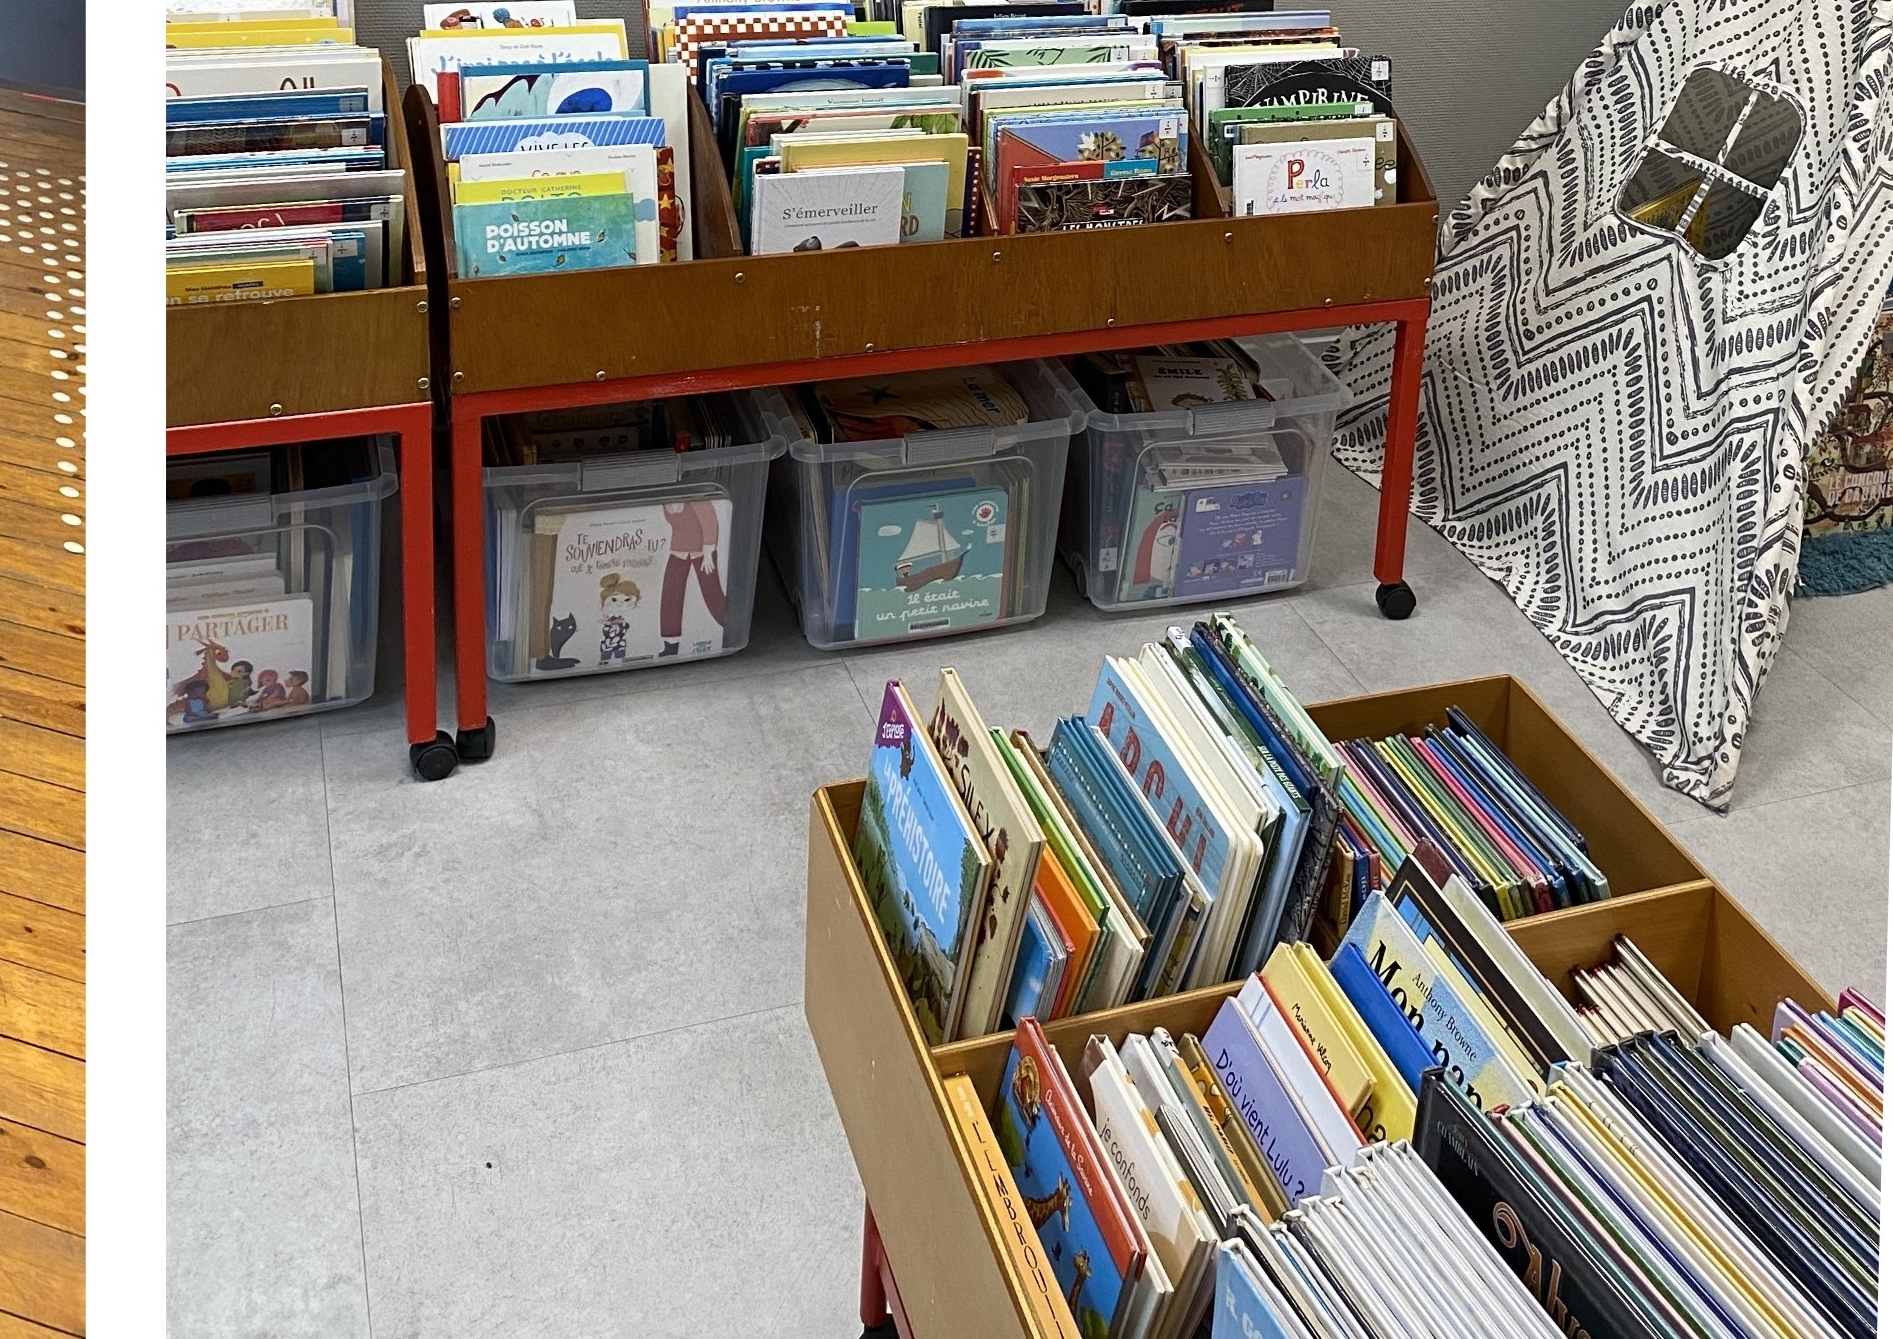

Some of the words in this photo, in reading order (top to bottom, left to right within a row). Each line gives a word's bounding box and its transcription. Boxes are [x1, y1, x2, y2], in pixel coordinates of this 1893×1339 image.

[1041, 174, 1079, 182] Morgenstern
[1287, 158, 1330, 190] Perla
[541, 184, 581, 192] CATHERINE
[782, 203, 879, 221] S'émerveiller
[485, 219, 568, 239] POISSON
[486, 231, 591, 253] D'AUTOMNE
[187, 293, 211, 305] se
[215, 287, 295, 300] retrouve
[1158, 367, 1203, 375] ÉMILE
[566, 529, 643, 562] SOUVIENDRAS
[577, 533, 588, 546] TE
[876, 610, 896, 622] un
[899, 604, 939, 622] petit
[943, 597, 990, 613] navire
[906, 594, 921, 605] Il
[924, 590, 961, 602] était
[178, 614, 289, 641] PARTAGER
[959, 763, 994, 843] SILEX
[887, 776, 951, 925] PRÉHISTOIRE
[1369, 940, 1426, 1034] Mon
[1412, 972, 1448, 1021] Anthony
[1445, 1012, 1477, 1062] Browne
[1214, 1047, 1244, 1098] D'où
[1240, 1093, 1270, 1138] vient
[1266, 1135, 1293, 1187] Lulu
[1291, 1180, 1305, 1203] ?
[1098, 1117, 1111, 1143] je
[1109, 1140, 1151, 1221] confonds
